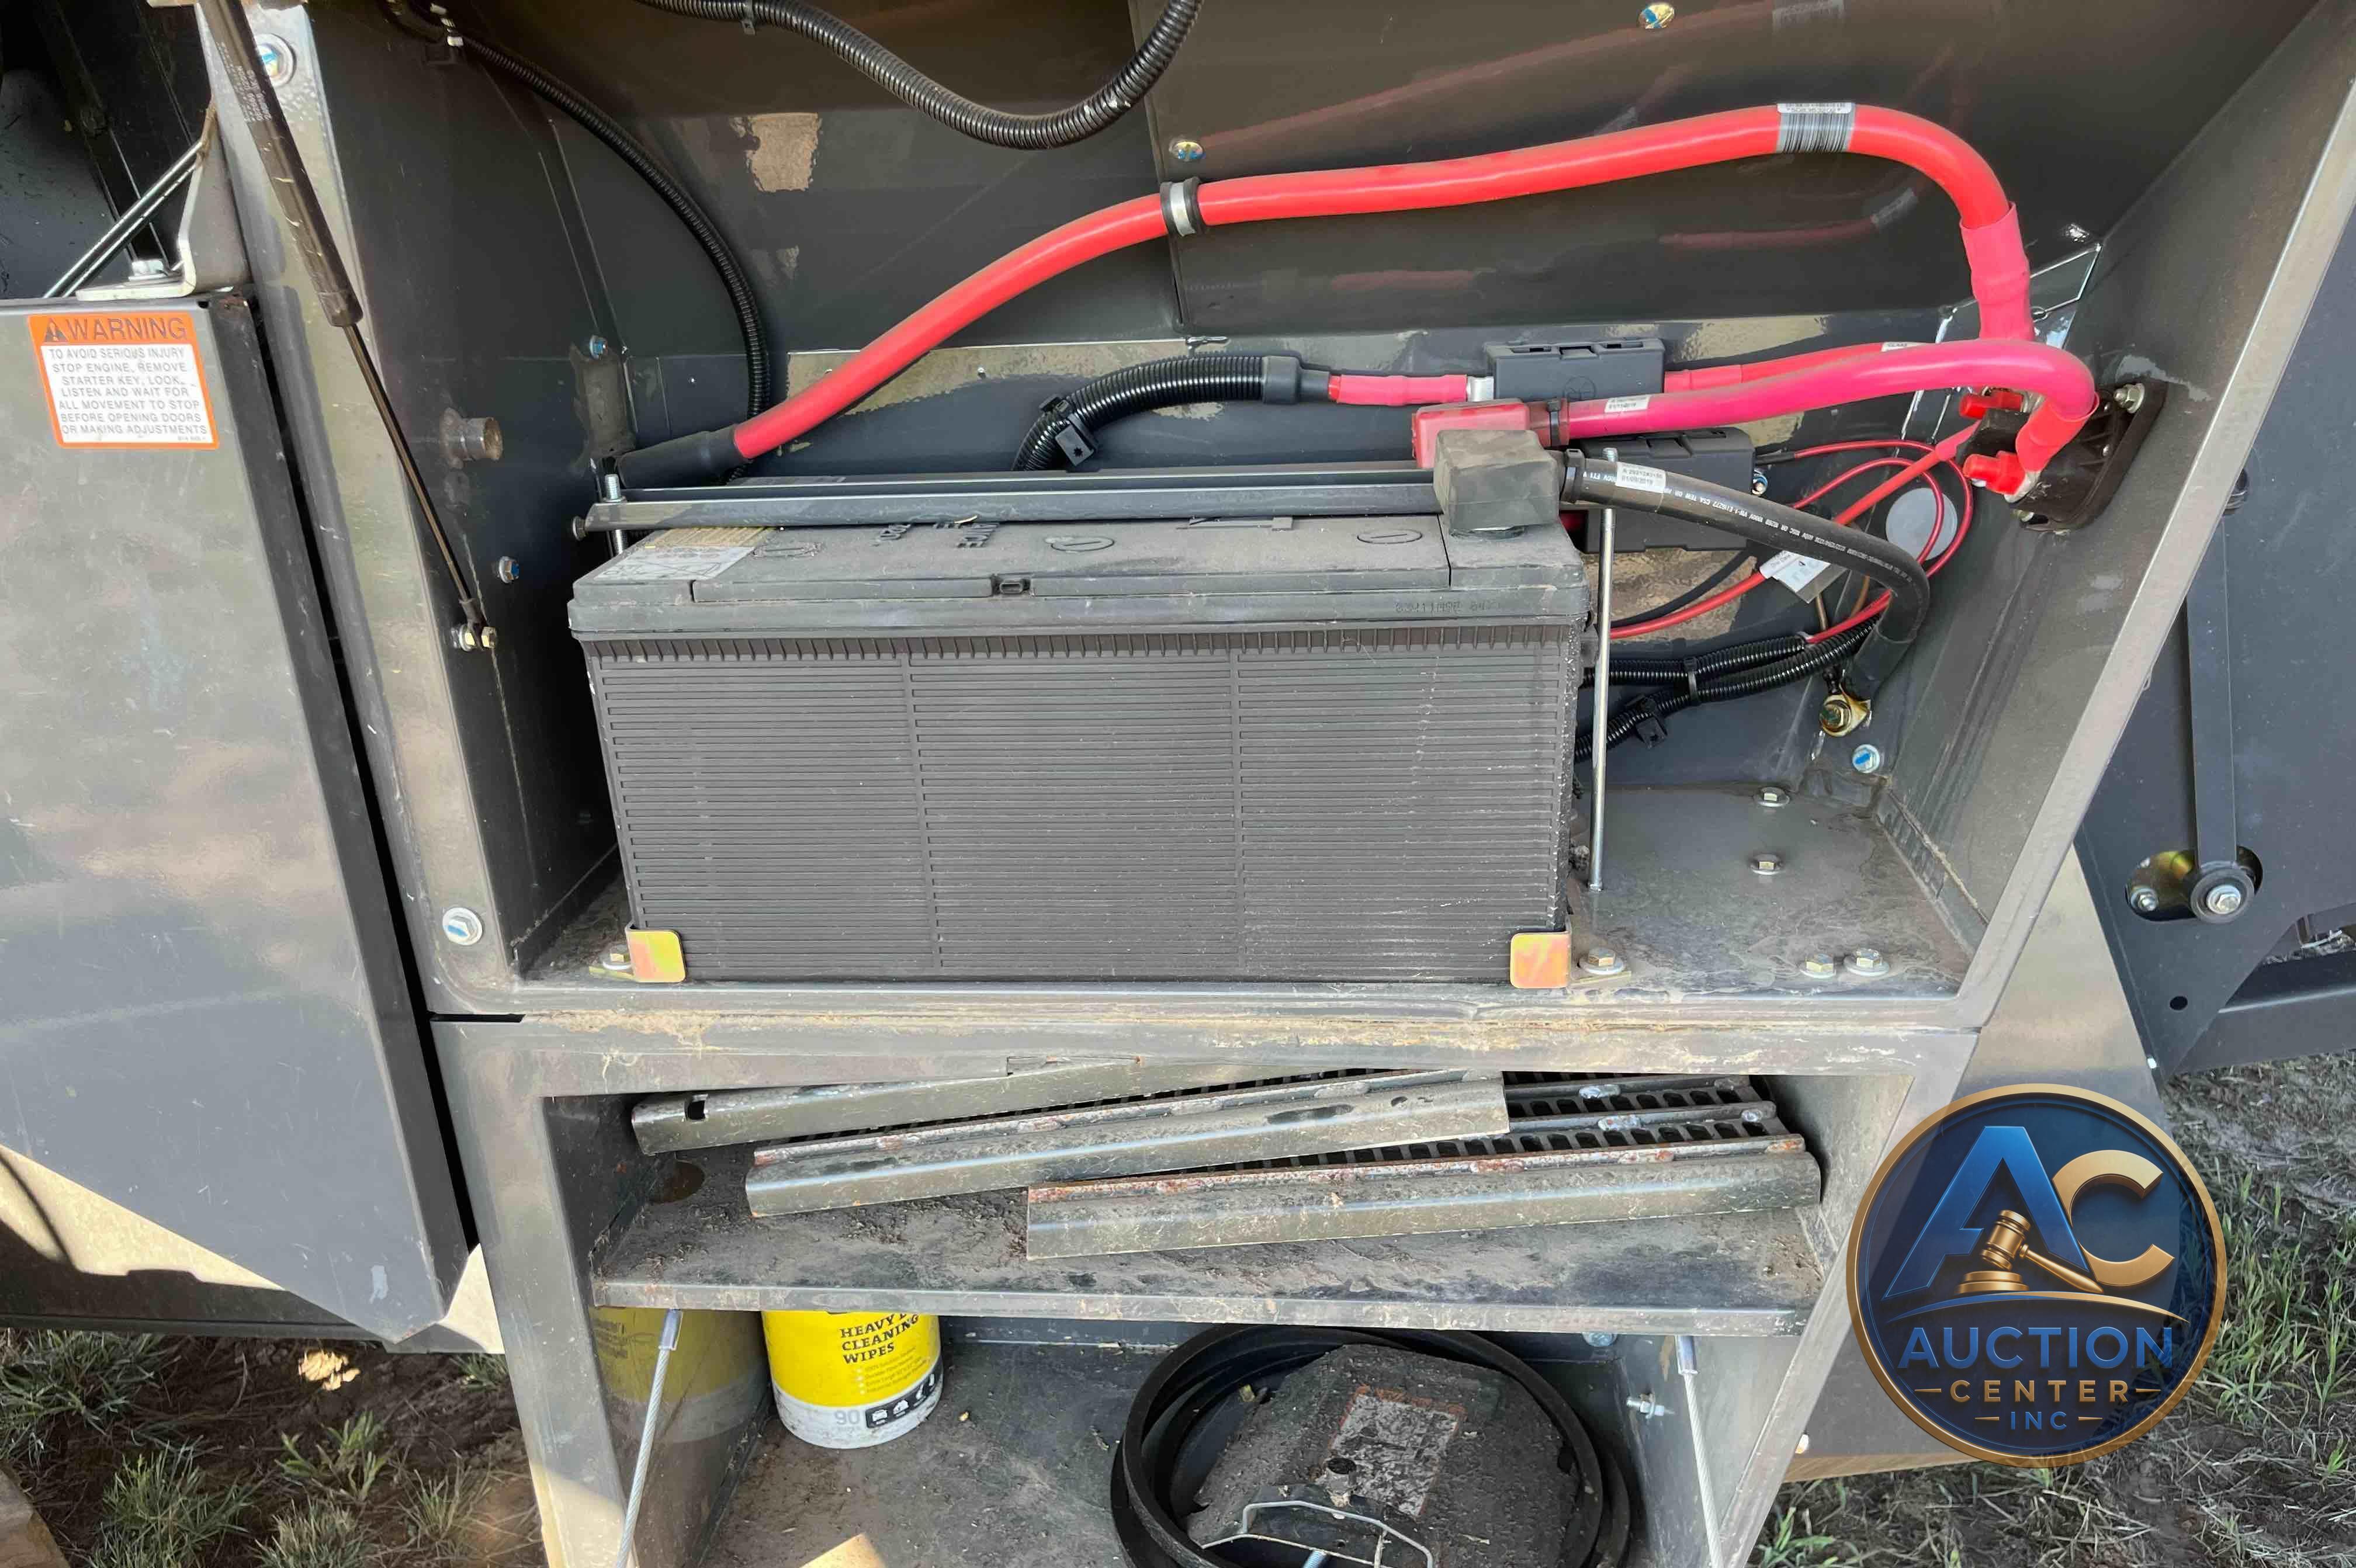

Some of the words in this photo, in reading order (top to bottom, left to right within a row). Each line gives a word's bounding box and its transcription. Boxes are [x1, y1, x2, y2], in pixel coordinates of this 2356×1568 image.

[65, 317, 188, 340] WARNING
[48, 349, 63, 359] TO
[66, 349, 97, 359] AVOID
[100, 348, 145, 359] SERIOUS
[148, 347, 185, 359] INJURY
[52, 363, 82, 373] STOP
[137, 362, 187, 373] REMOVE
[62, 376, 114, 386] STARTER
[61, 387, 102, 397] LISTEN
[105, 387, 128, 397] AND
[131, 387, 160, 397] WAIT
[164, 387, 189, 397] FOR
[59, 400, 79, 410] ALL
[81, 400, 146, 410] MOVEMENT
[148, 400, 166, 410] TO
[169, 400, 200, 410] STOP
[60, 412, 104, 423] BEFORE
[108, 412, 158, 423] OPENING
[161, 412, 202, 423] DOORS
[61, 425, 77, 435] OR
[80, 425, 123, 435] MAKING
[126, 425, 207, 435] ADJUSTMENTS
[840, 1314, 895, 1338] HEAVY
[841, 1313, 919, 1351] CLEANING
[843, 1342, 895, 1364] WIPES
[834, 1410, 861, 1425] 90
